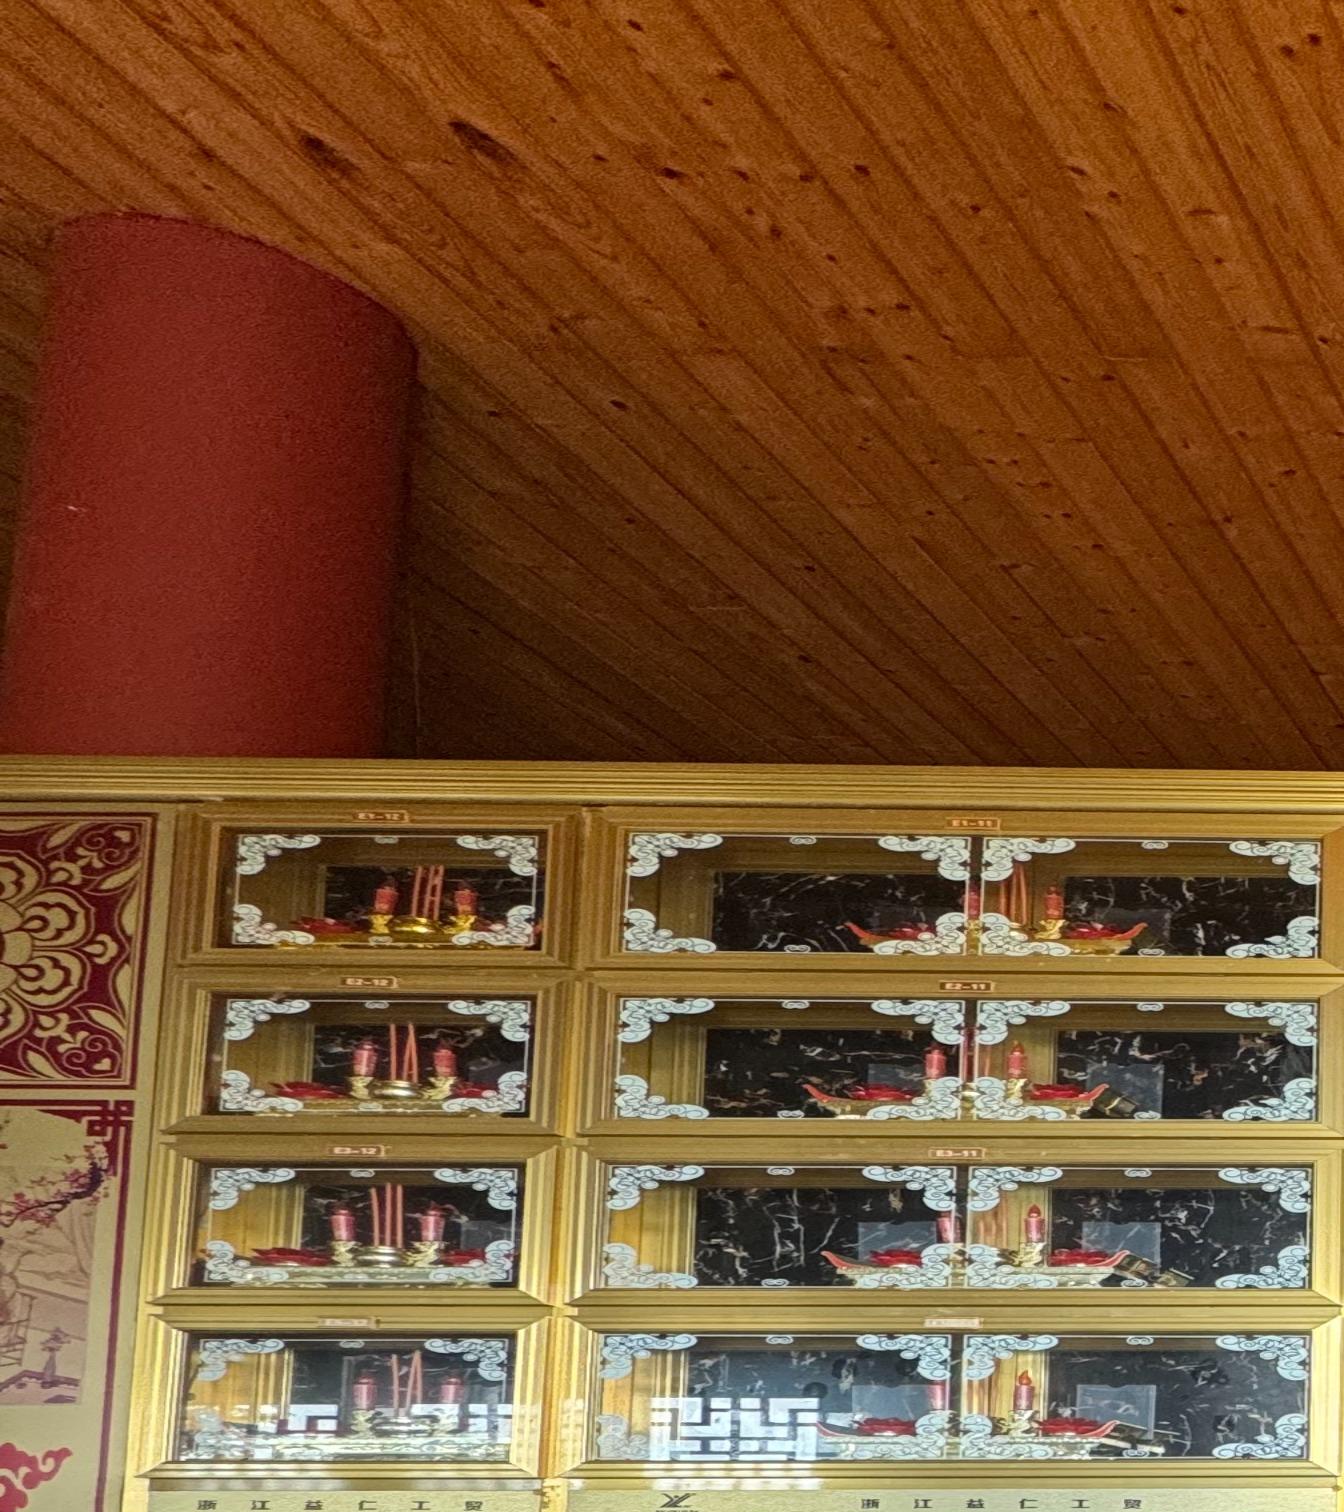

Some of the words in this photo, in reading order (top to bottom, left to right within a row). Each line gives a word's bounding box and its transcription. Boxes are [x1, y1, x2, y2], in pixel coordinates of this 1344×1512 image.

[951, 819, 993, 828] E1-11
[345, 977, 389, 986] E2-12
[944, 982, 987, 990] E2-11
